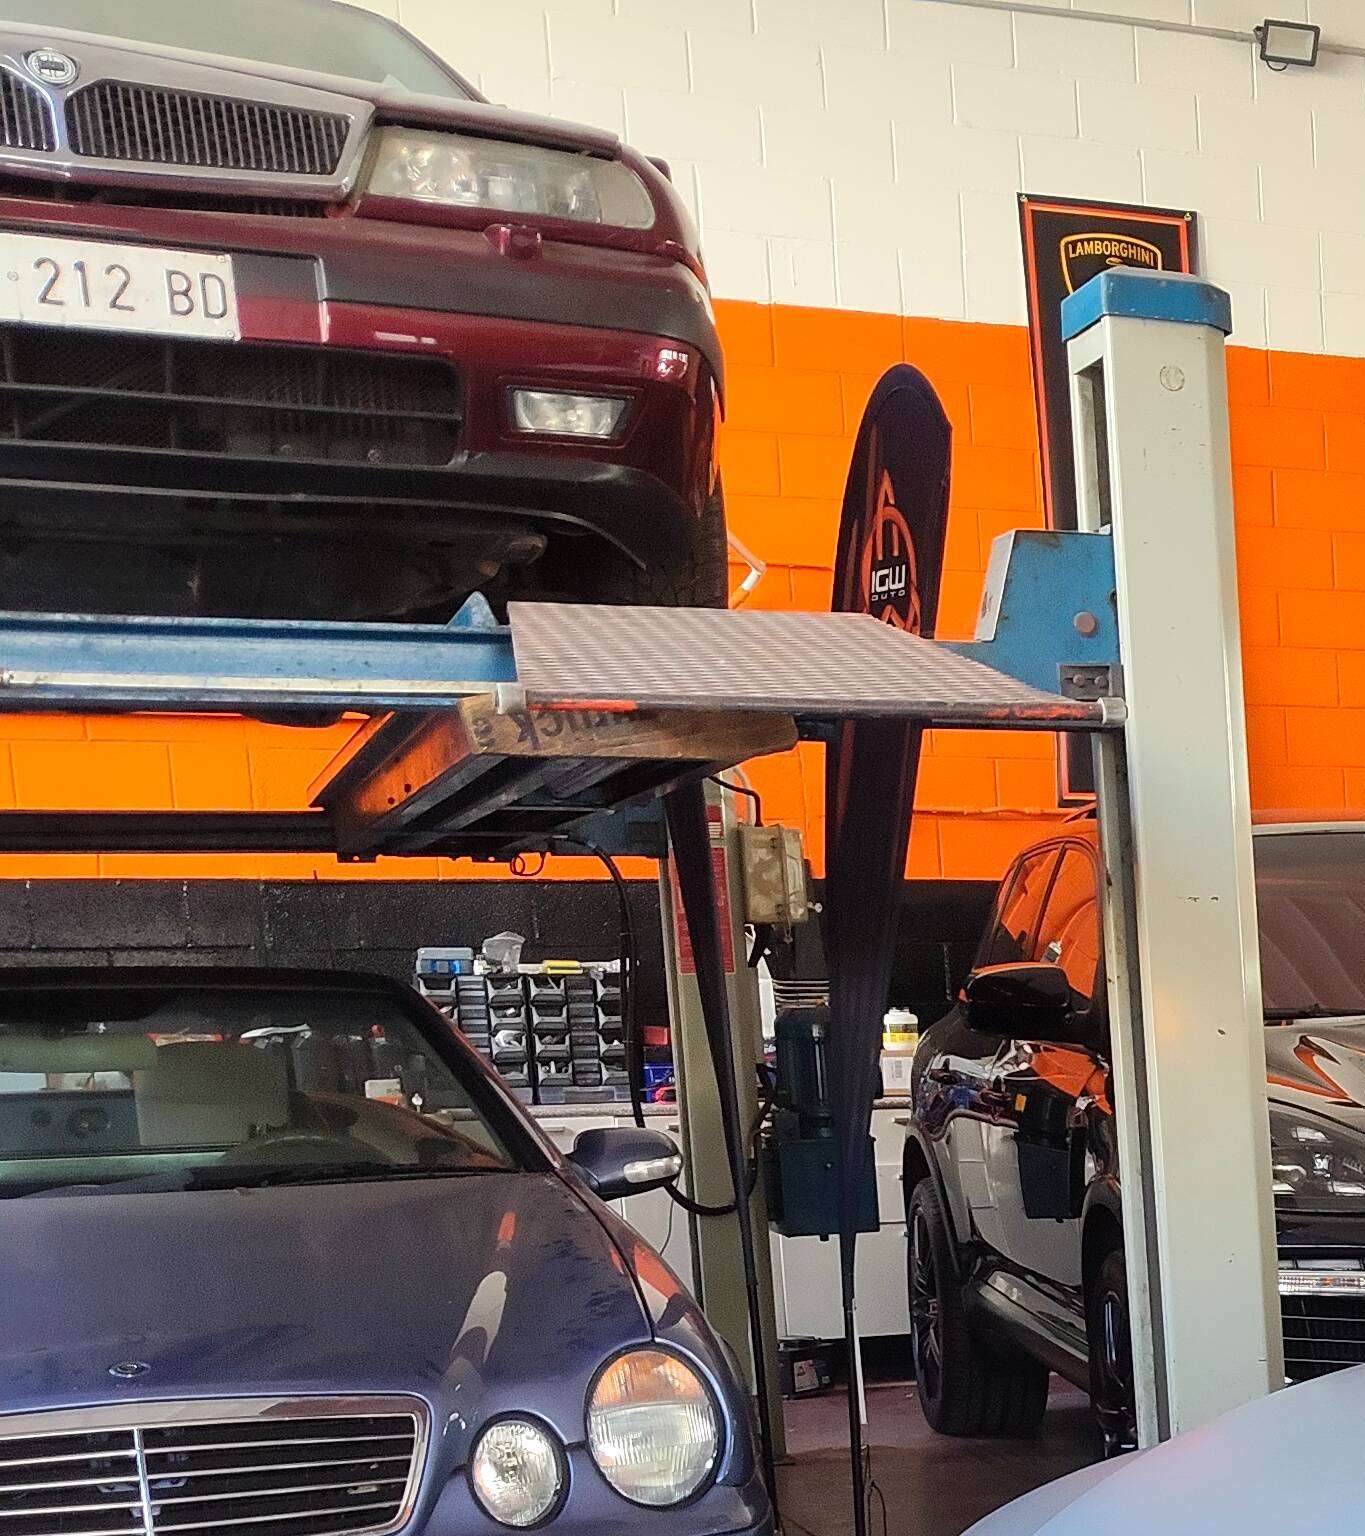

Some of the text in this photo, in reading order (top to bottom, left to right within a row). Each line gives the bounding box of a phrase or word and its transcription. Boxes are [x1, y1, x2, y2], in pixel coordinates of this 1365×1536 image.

[1068, 241, 1155, 267] LAMBORGHINI
[33, 256, 229, 320] 212 BD
[870, 564, 906, 595] IGW
